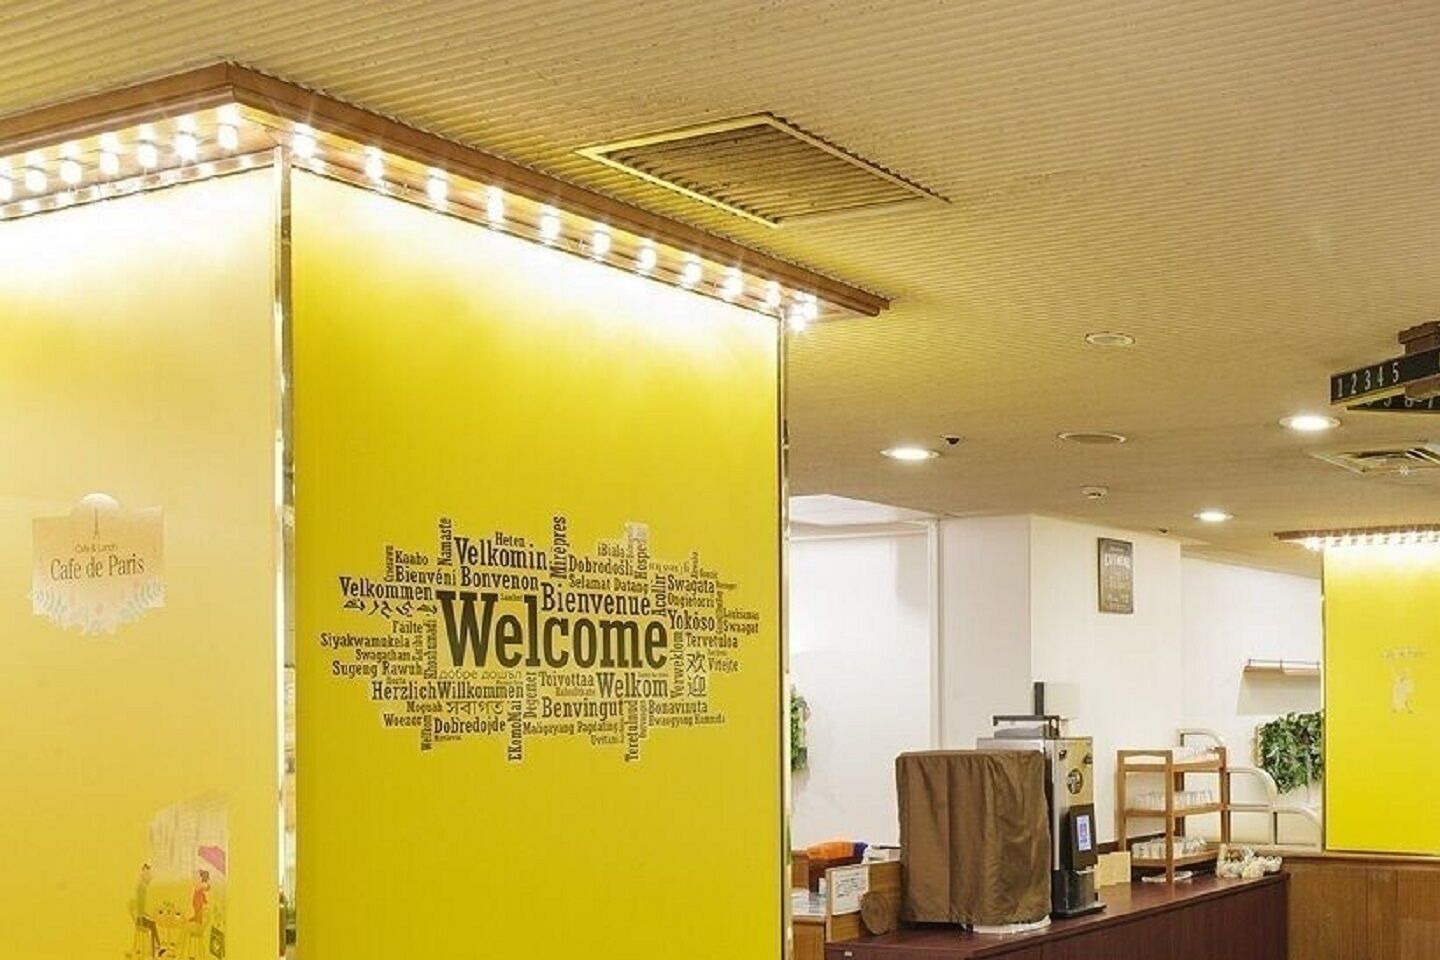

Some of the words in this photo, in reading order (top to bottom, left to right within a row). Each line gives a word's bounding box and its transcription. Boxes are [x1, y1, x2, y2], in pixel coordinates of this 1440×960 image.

[1337, 378, 1344, 397] 1
[1350, 373, 1358, 394] 2
[1364, 370, 1371, 390] 3
[1376, 366, 1384, 386] 4
[1392, 362, 1400, 383] 5
[437, 517, 453, 567] Namaste
[453, 536, 547, 571] Velkomin
[50, 557, 82, 581] Cafe
[86, 555, 103, 578] de
[108, 553, 145, 576] Paris
[460, 565, 539, 591] Bonvenon
[338, 576, 434, 601] Velkommen
[569, 573, 611, 591] Selamat
[667, 574, 715, 595] Swagata
[541, 582, 651, 616] Bienvenue
[436, 590, 668, 669] Welcome
[596, 671, 668, 699] Welkom
[541, 695, 624, 721] Benvingut
